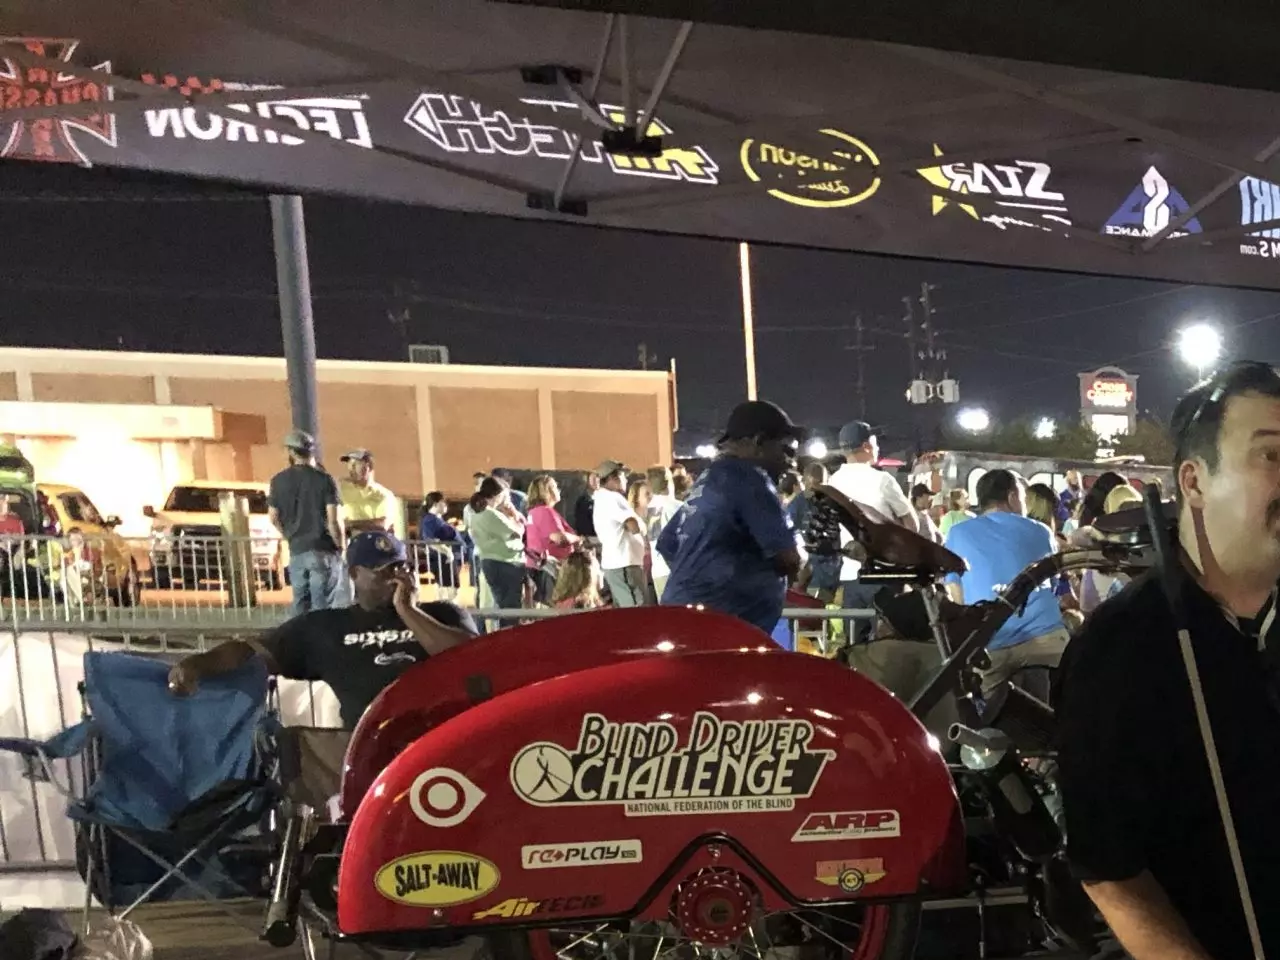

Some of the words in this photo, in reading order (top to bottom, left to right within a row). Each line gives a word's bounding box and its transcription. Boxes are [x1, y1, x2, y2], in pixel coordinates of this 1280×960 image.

[580, 715, 675, 758] BLIND
[690, 714, 809, 757] DRIVER
[572, 751, 800, 800] CHALLENGE
[627, 803, 671, 814] NATIONAL
[673, 801, 729, 812] FEDERATION
[731, 800, 744, 810] OF
[746, 799, 763, 809] THE
[765, 798, 793, 809] BLIND
[800, 811, 896, 831] ARP
[394, 861, 481, 897] SALT-AWAY
